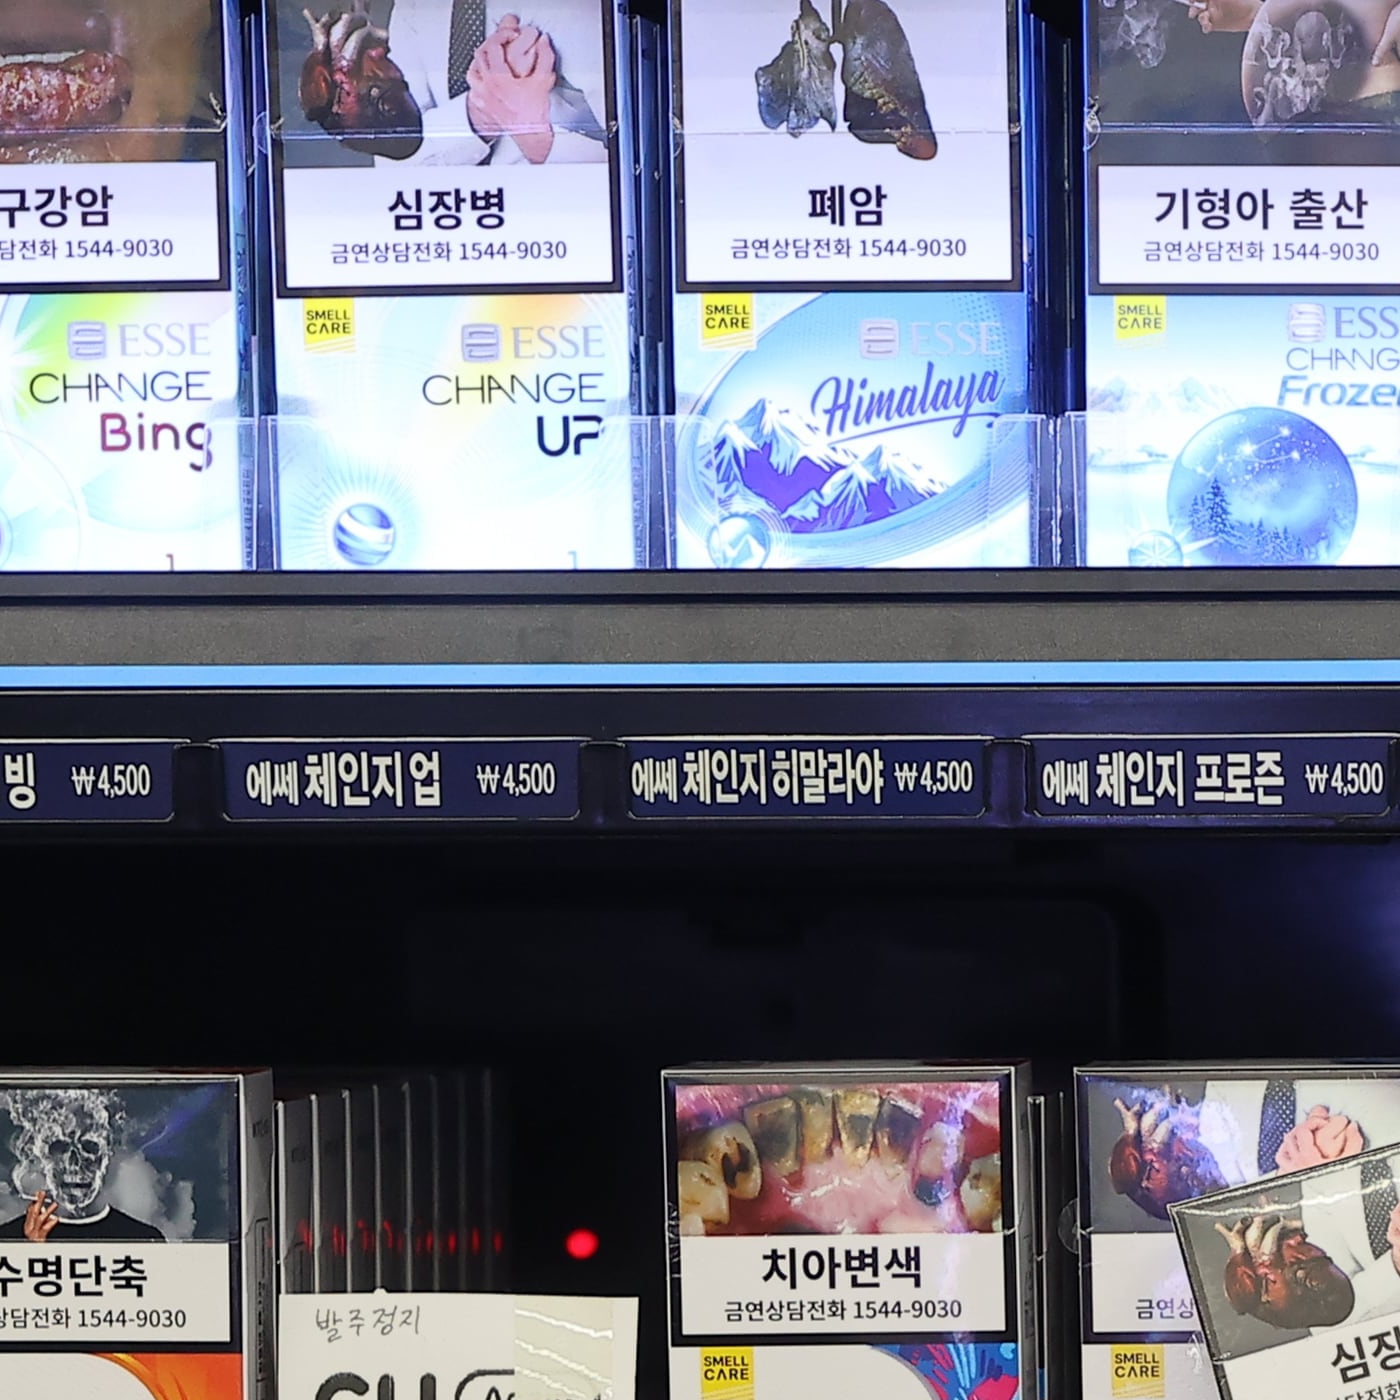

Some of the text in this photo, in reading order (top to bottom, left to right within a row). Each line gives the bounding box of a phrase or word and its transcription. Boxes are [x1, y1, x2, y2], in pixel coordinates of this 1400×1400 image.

[388, 188, 504, 230] 심장병
[809, 185, 887, 226] 폐암
[1156, 188, 1368, 230] 기형아 출산
[807, 361, 1009, 440] Himalaya
[100, 412, 213, 472] Bing
[537, 415, 603, 457] UP
[632, 758, 677, 803] 에쎄
[894, 761, 972, 794] ₩4,500
[763, 1246, 920, 1289] 치아변색
